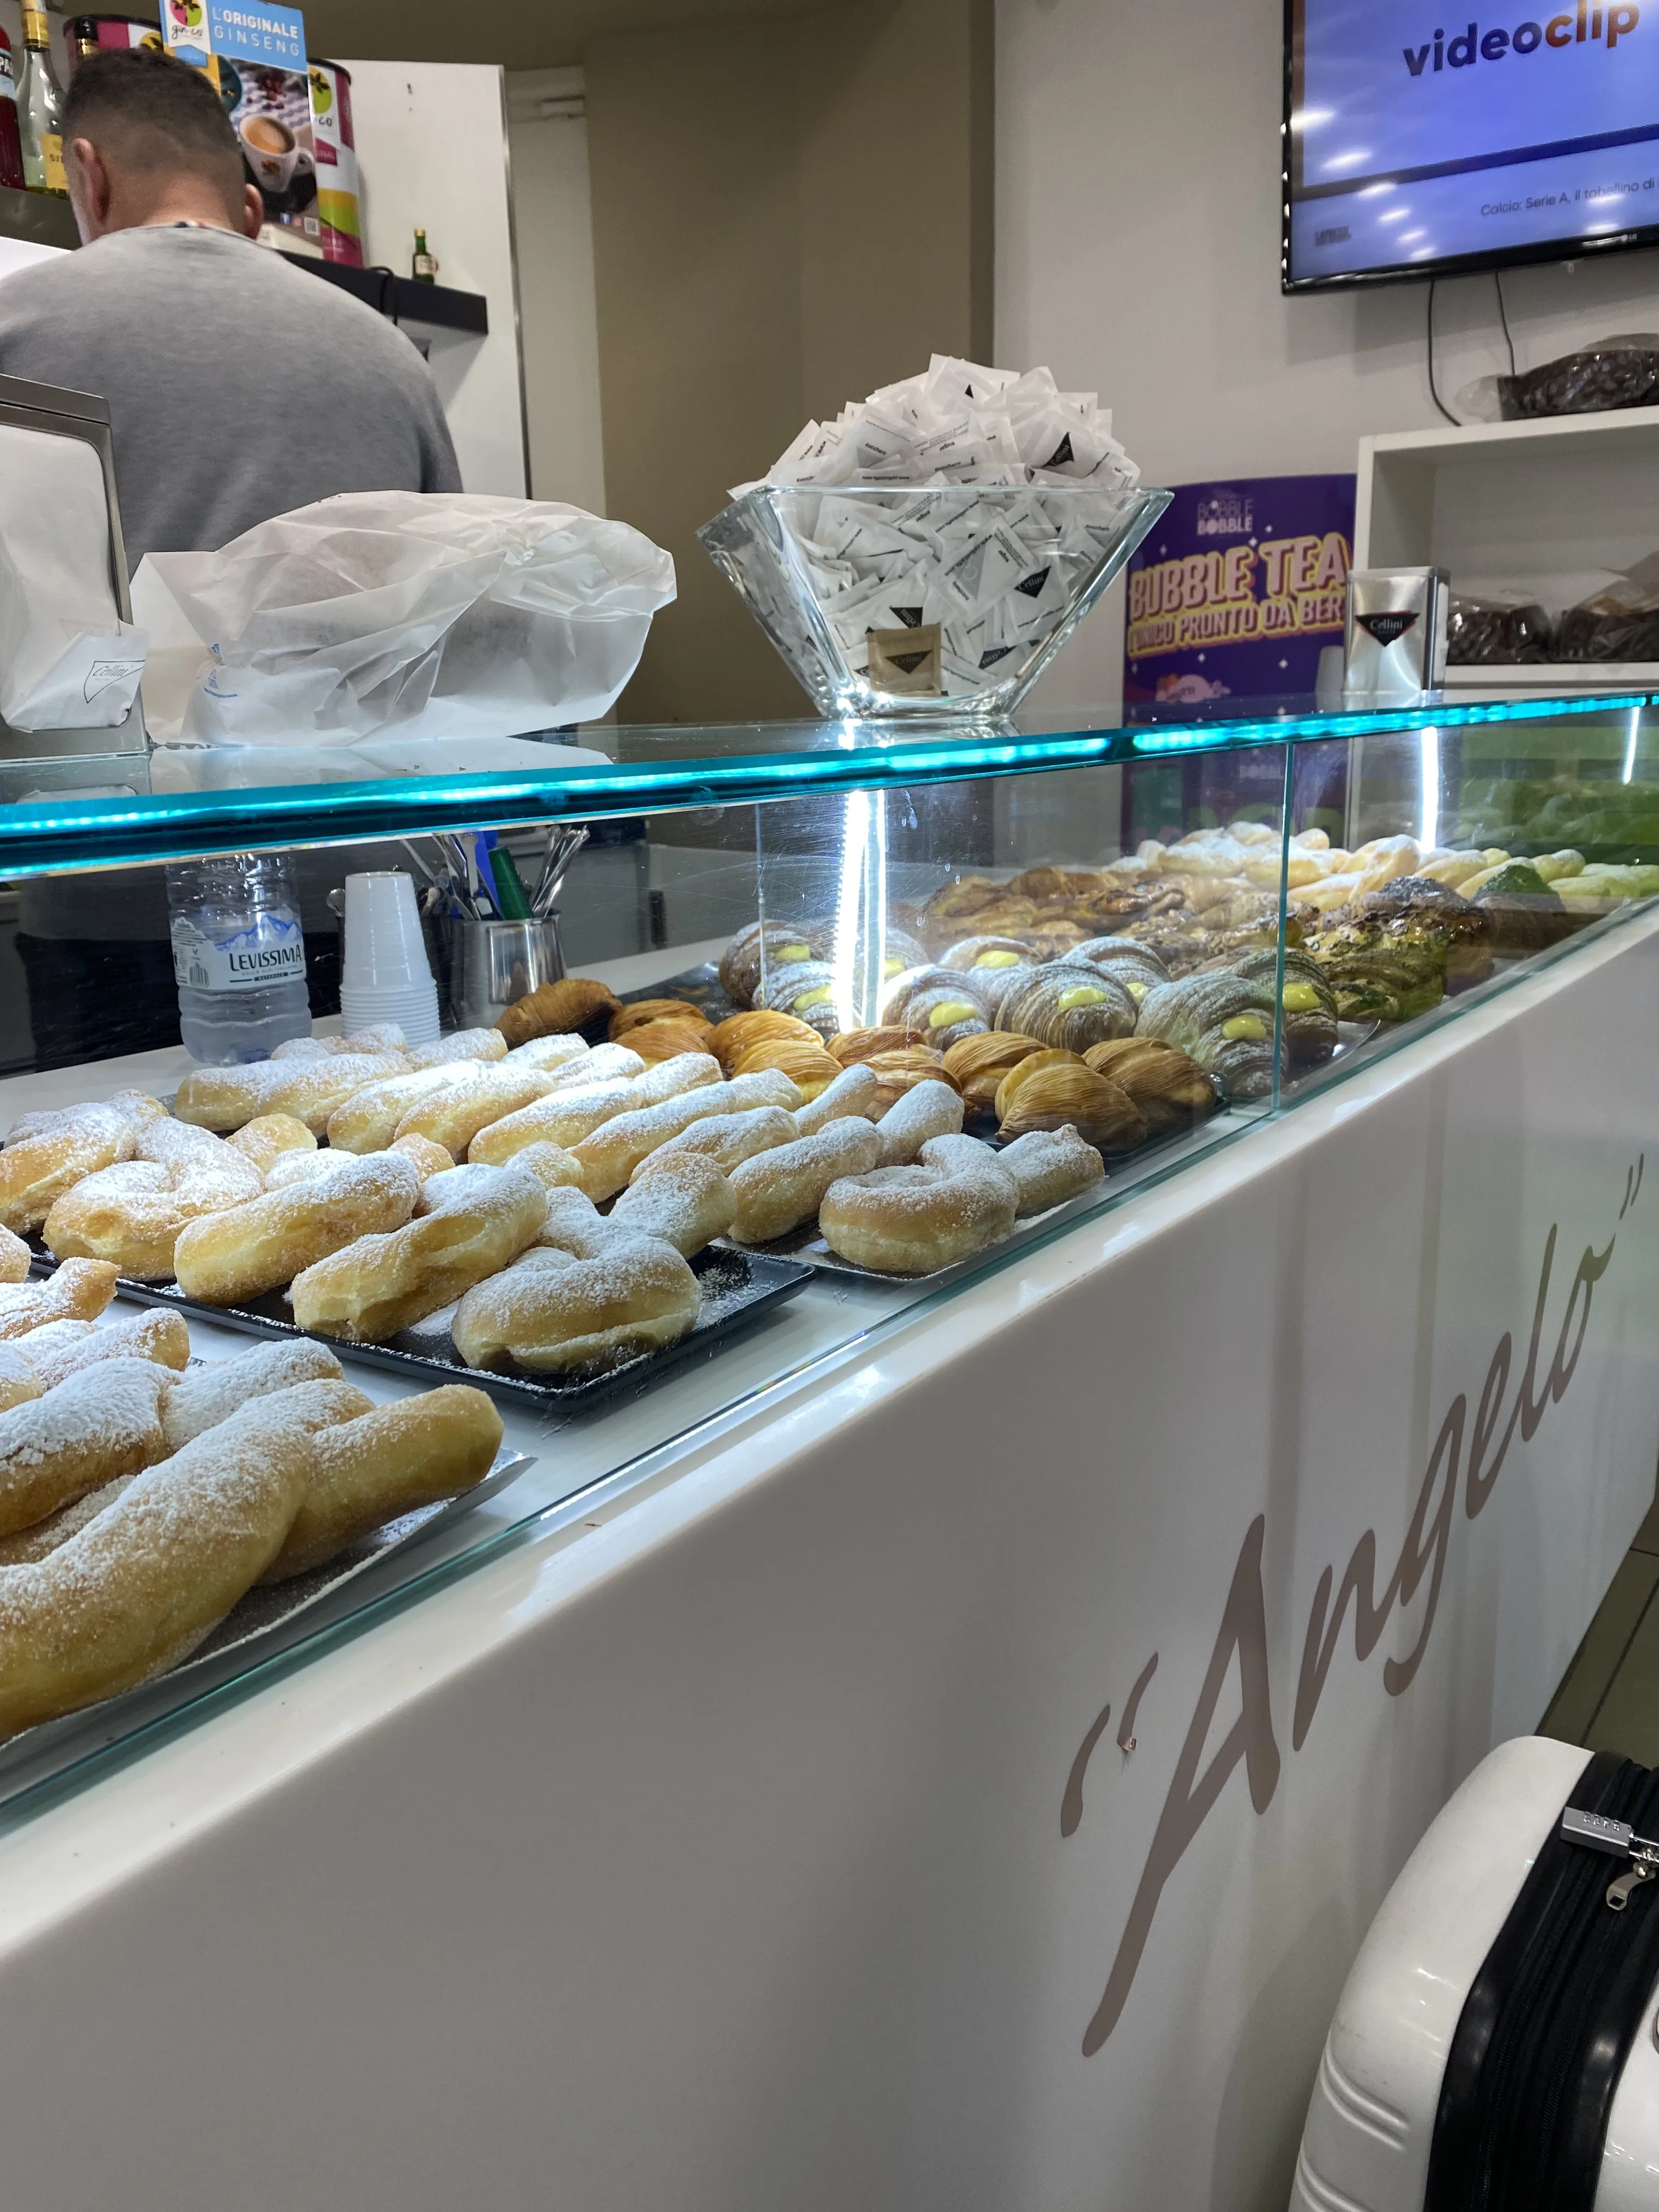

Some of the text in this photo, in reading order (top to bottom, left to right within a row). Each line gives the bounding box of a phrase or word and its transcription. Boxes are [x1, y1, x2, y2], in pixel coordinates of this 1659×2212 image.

[212, 7, 298, 39] L'ORIGINALE
[1403, 0, 1640, 76] videoclip
[214, 25, 299, 56] GINSENG
[1481, 201, 1522, 216] Calcio:
[1526, 195, 1556, 208] Serie
[1575, 189, 1581, 201] il
[1643, 177, 1655, 190] di
[1130, 535, 1346, 622] BUBBLE TEA
[1180, 605, 1258, 642] PRONTO
[1263, 601, 1294, 630] DA
[1300, 594, 1346, 625] BER
[1370, 618, 1403, 631] Cellini
[93, 665, 133, 676] Cellini
[229, 944, 302, 972] LEVISSIMA
